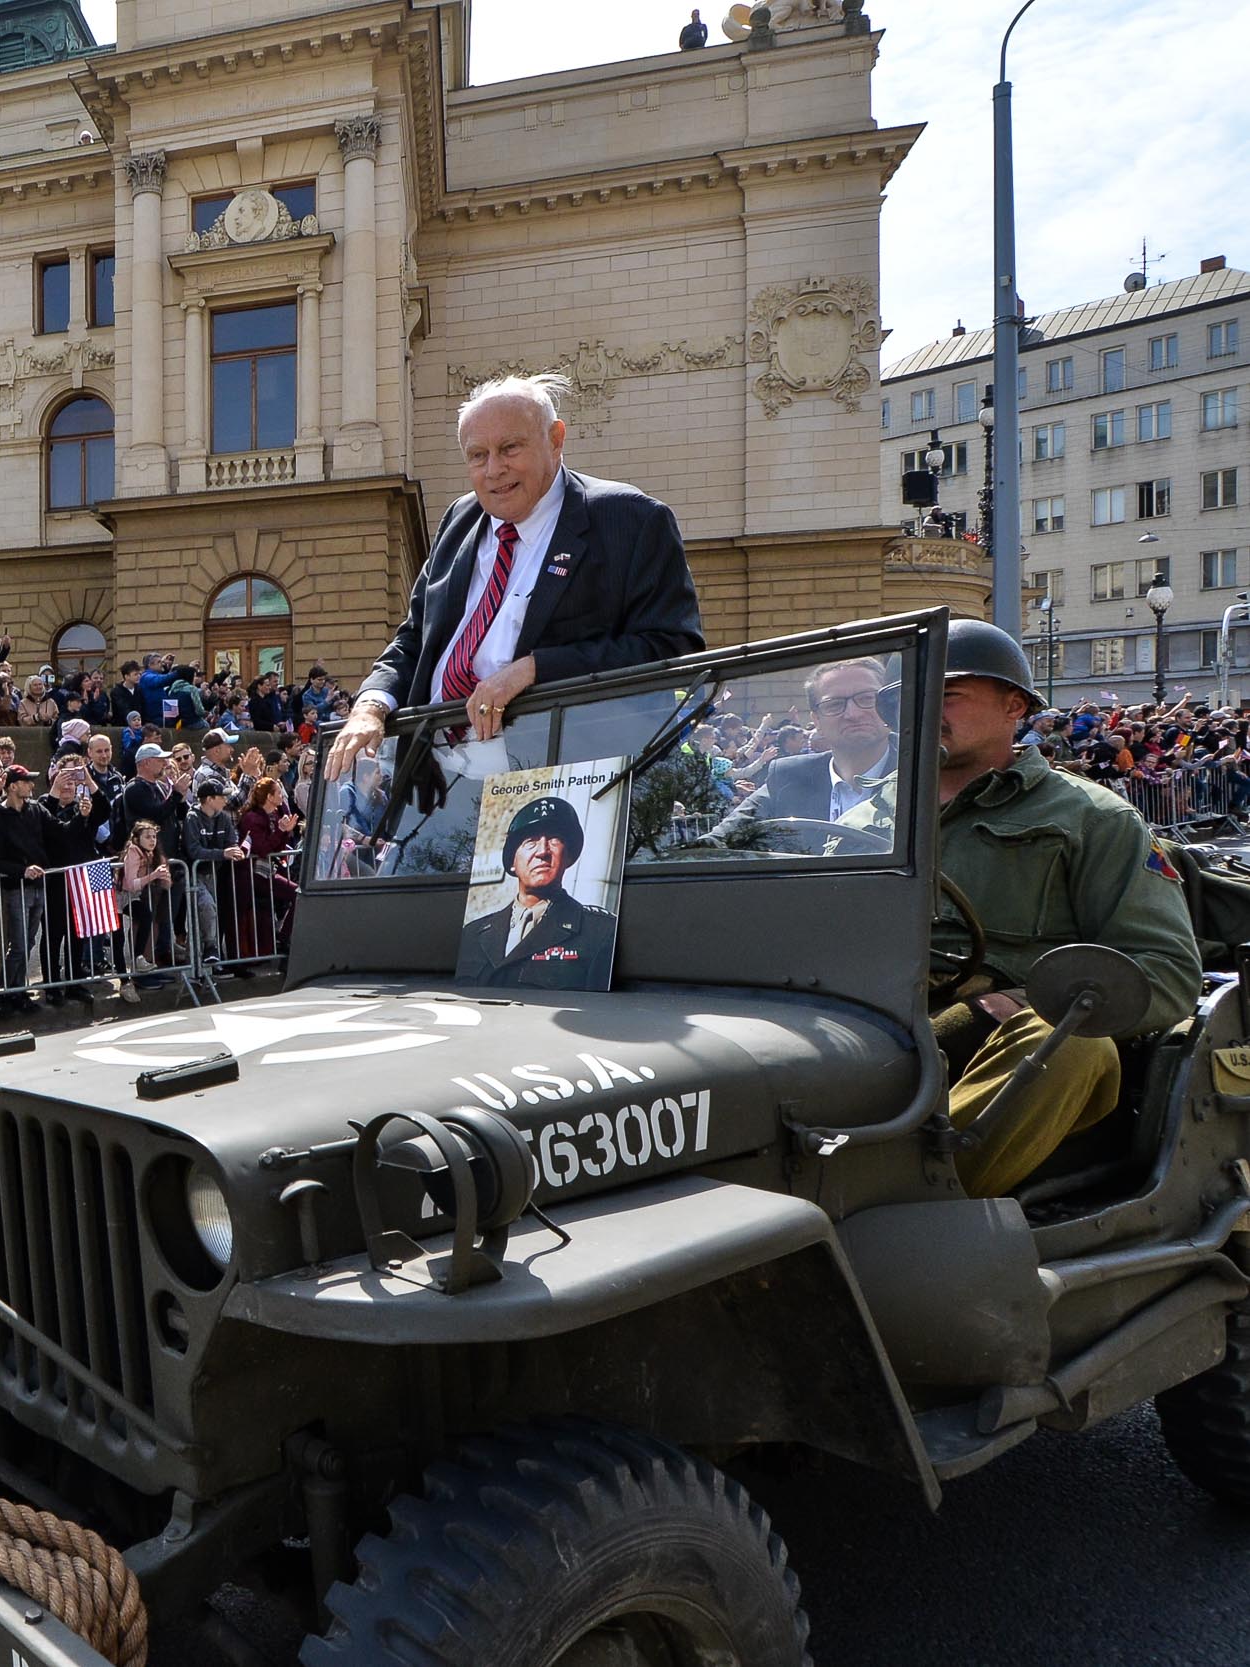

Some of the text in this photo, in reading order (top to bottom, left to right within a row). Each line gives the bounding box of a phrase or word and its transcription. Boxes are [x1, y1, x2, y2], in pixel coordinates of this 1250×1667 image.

[491, 784, 530, 796] George
[532, 778, 565, 791] Smith
[568, 774, 606, 787] Patton
[450, 1053, 656, 1111] U.S.A.
